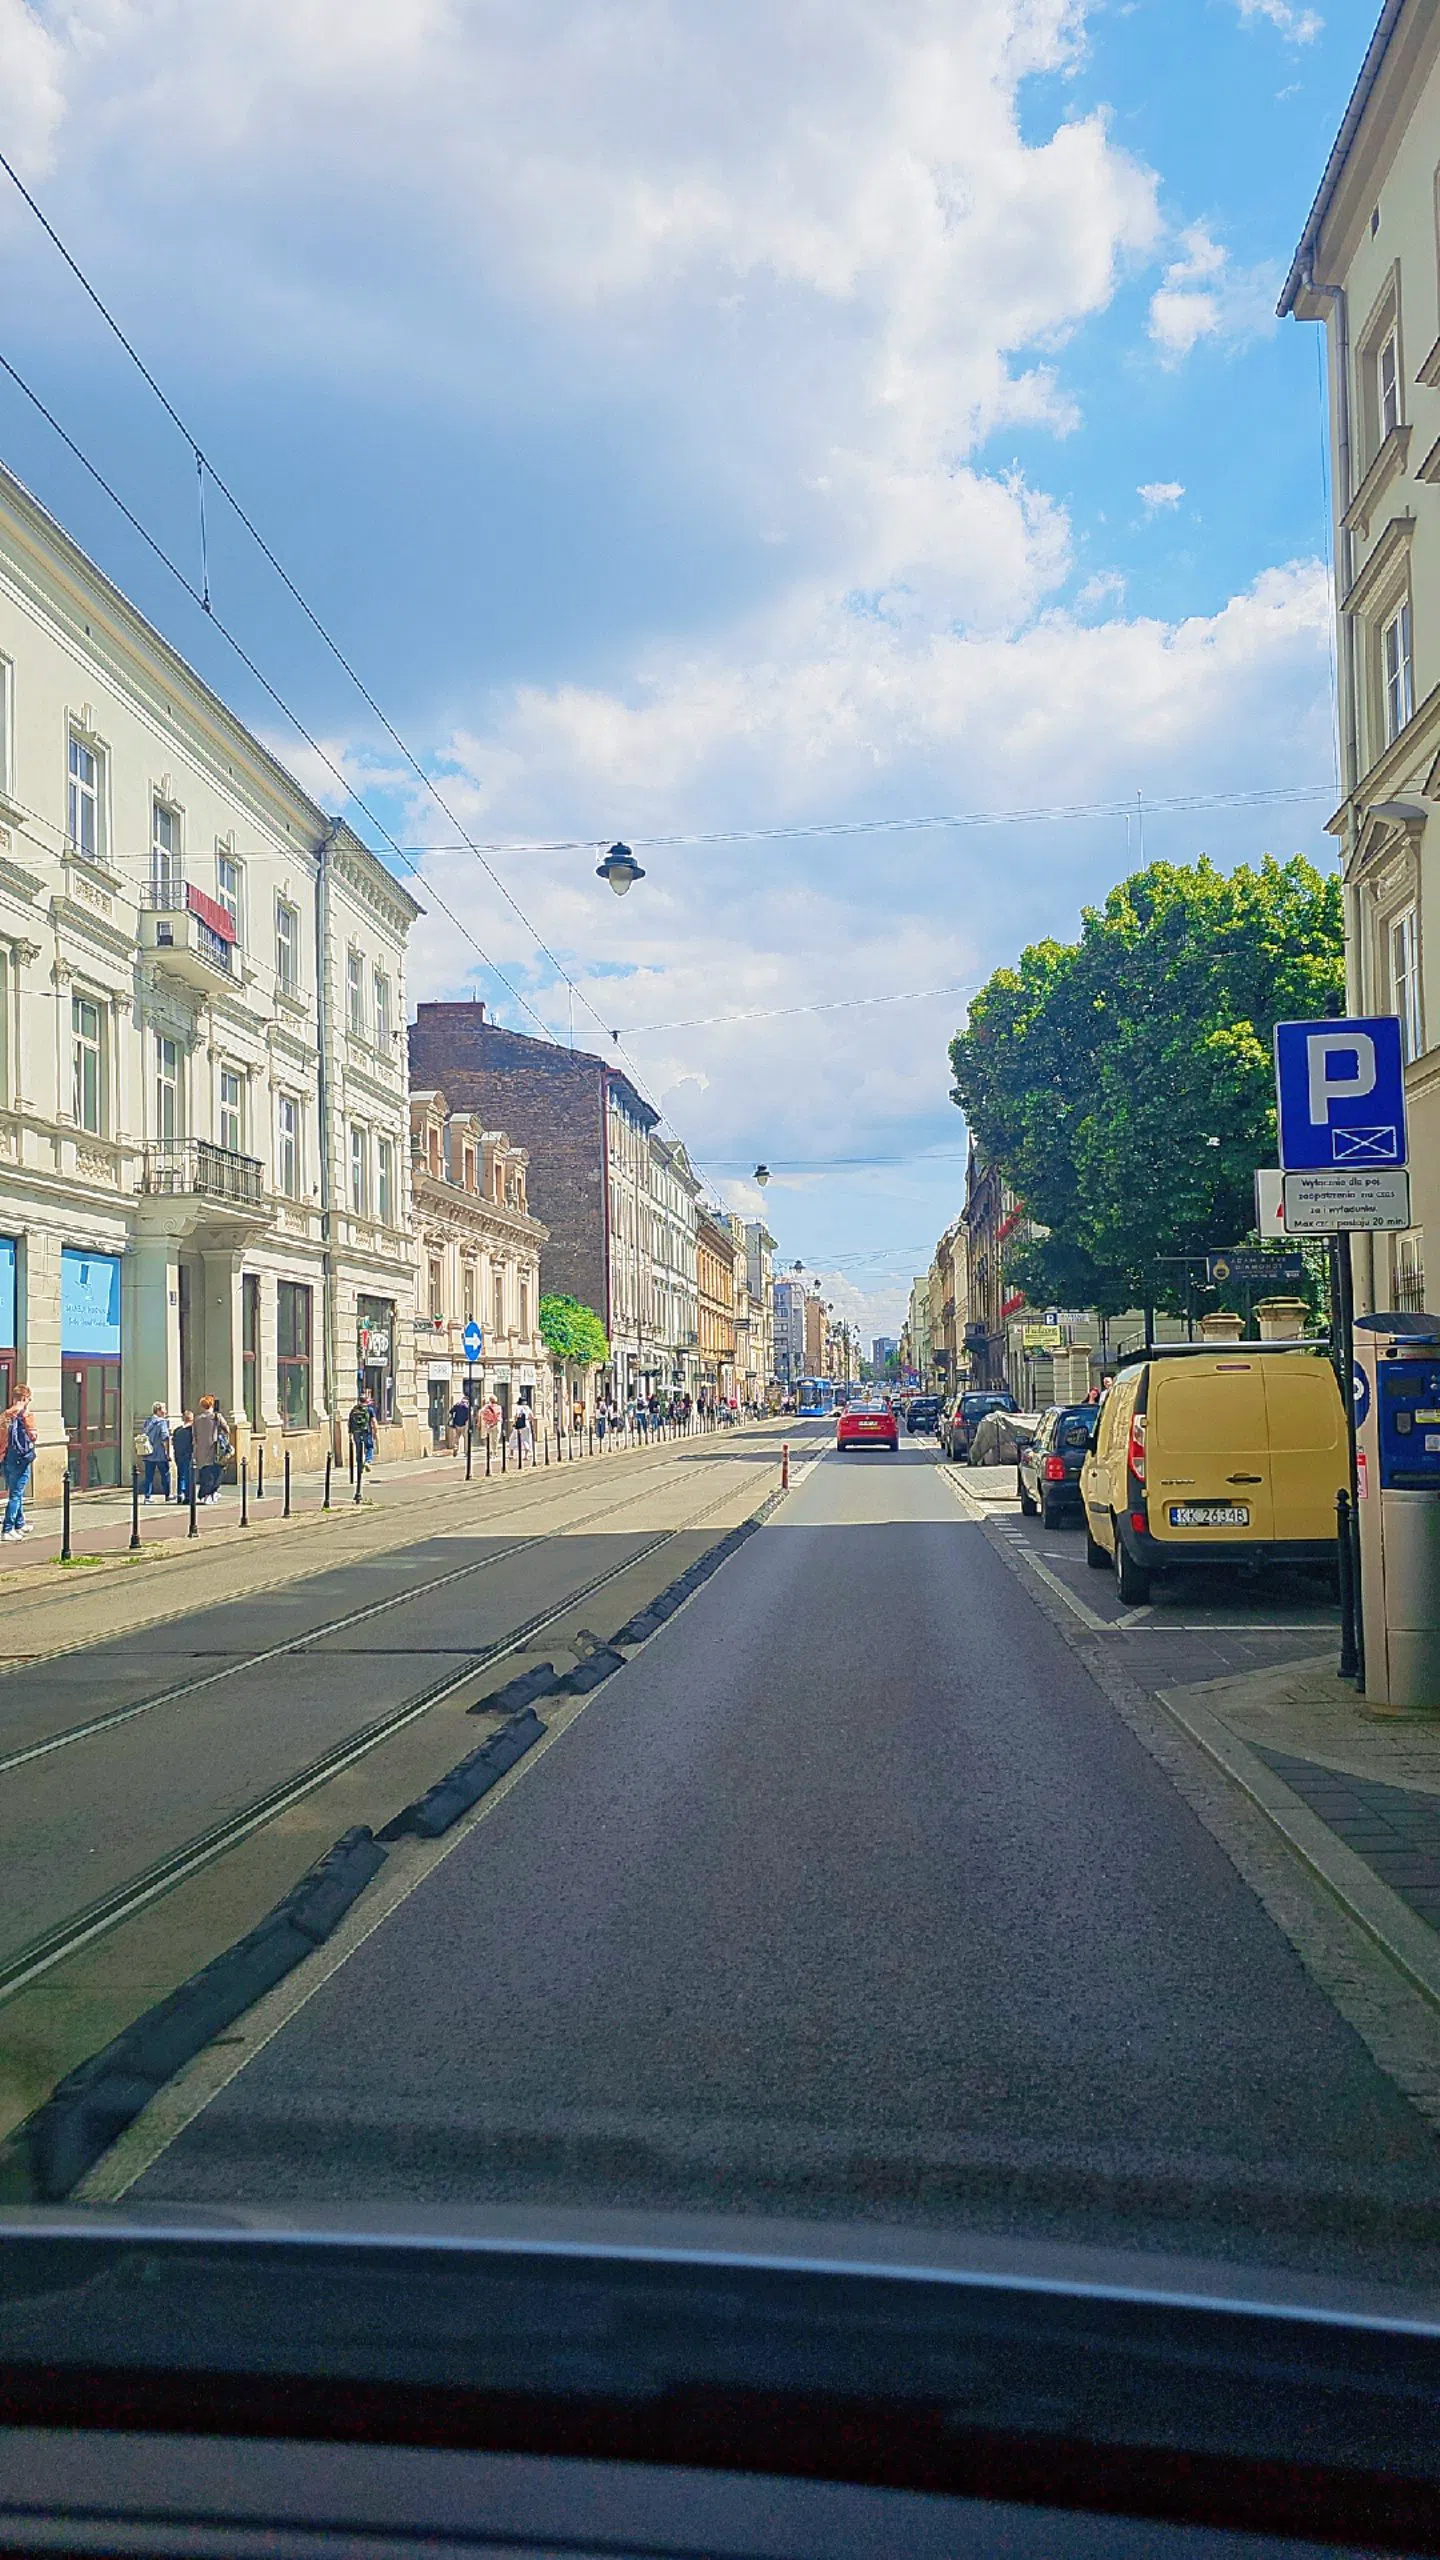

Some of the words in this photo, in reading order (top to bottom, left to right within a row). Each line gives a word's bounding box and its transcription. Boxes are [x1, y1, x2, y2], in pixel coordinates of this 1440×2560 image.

[1307, 1033, 1376, 1125] P
[1349, 1178, 1362, 1186] dla
[1373, 1217, 1384, 1226] 20
[1180, 1508, 1197, 1521] KK
